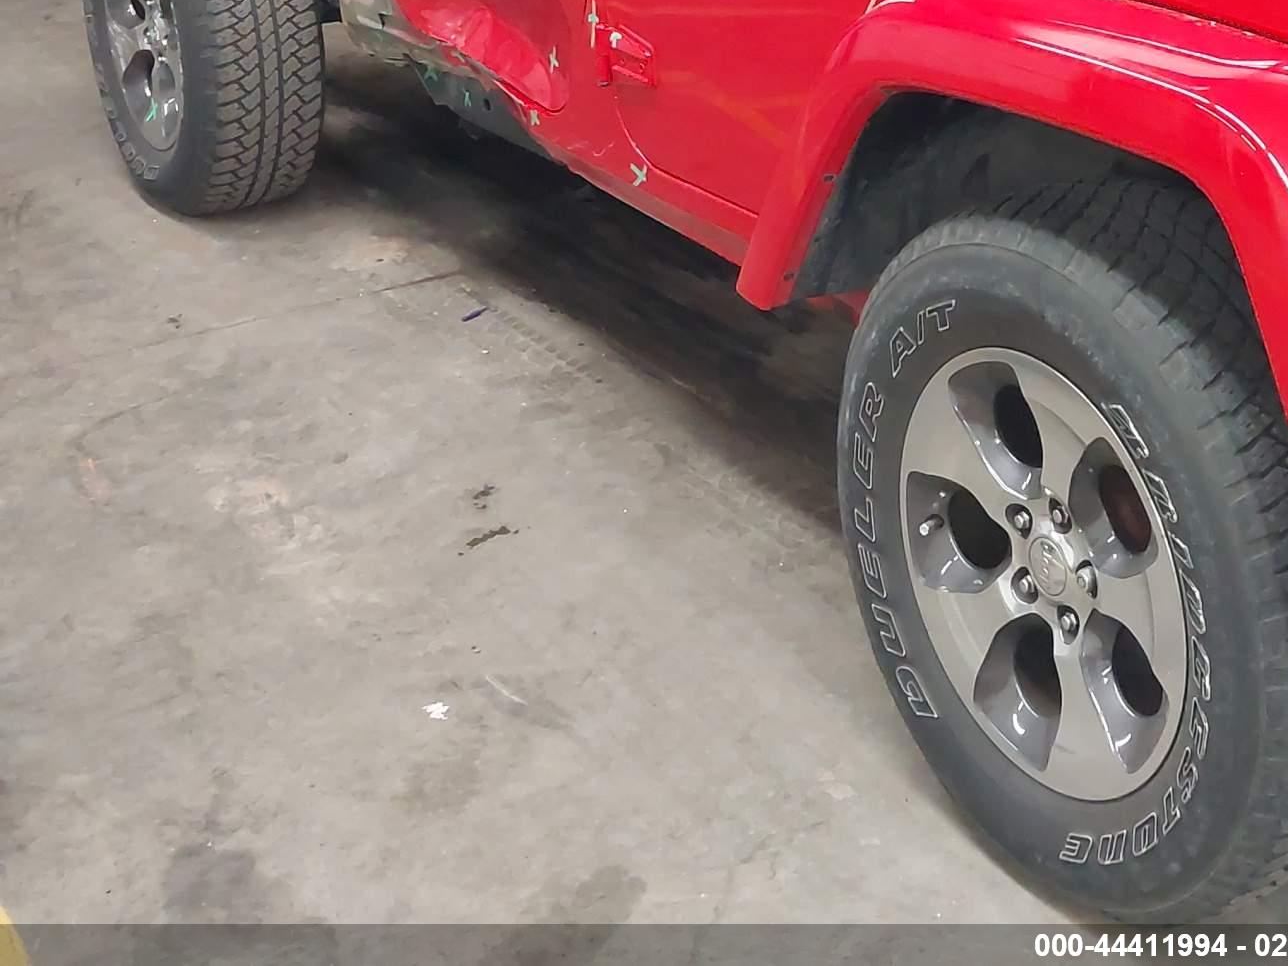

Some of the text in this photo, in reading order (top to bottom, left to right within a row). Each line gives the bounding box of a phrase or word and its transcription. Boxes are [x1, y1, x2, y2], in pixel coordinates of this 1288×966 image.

[853, 299, 957, 719] DUELER A/T
[1058, 401, 1212, 866] BRIDGESTONE
